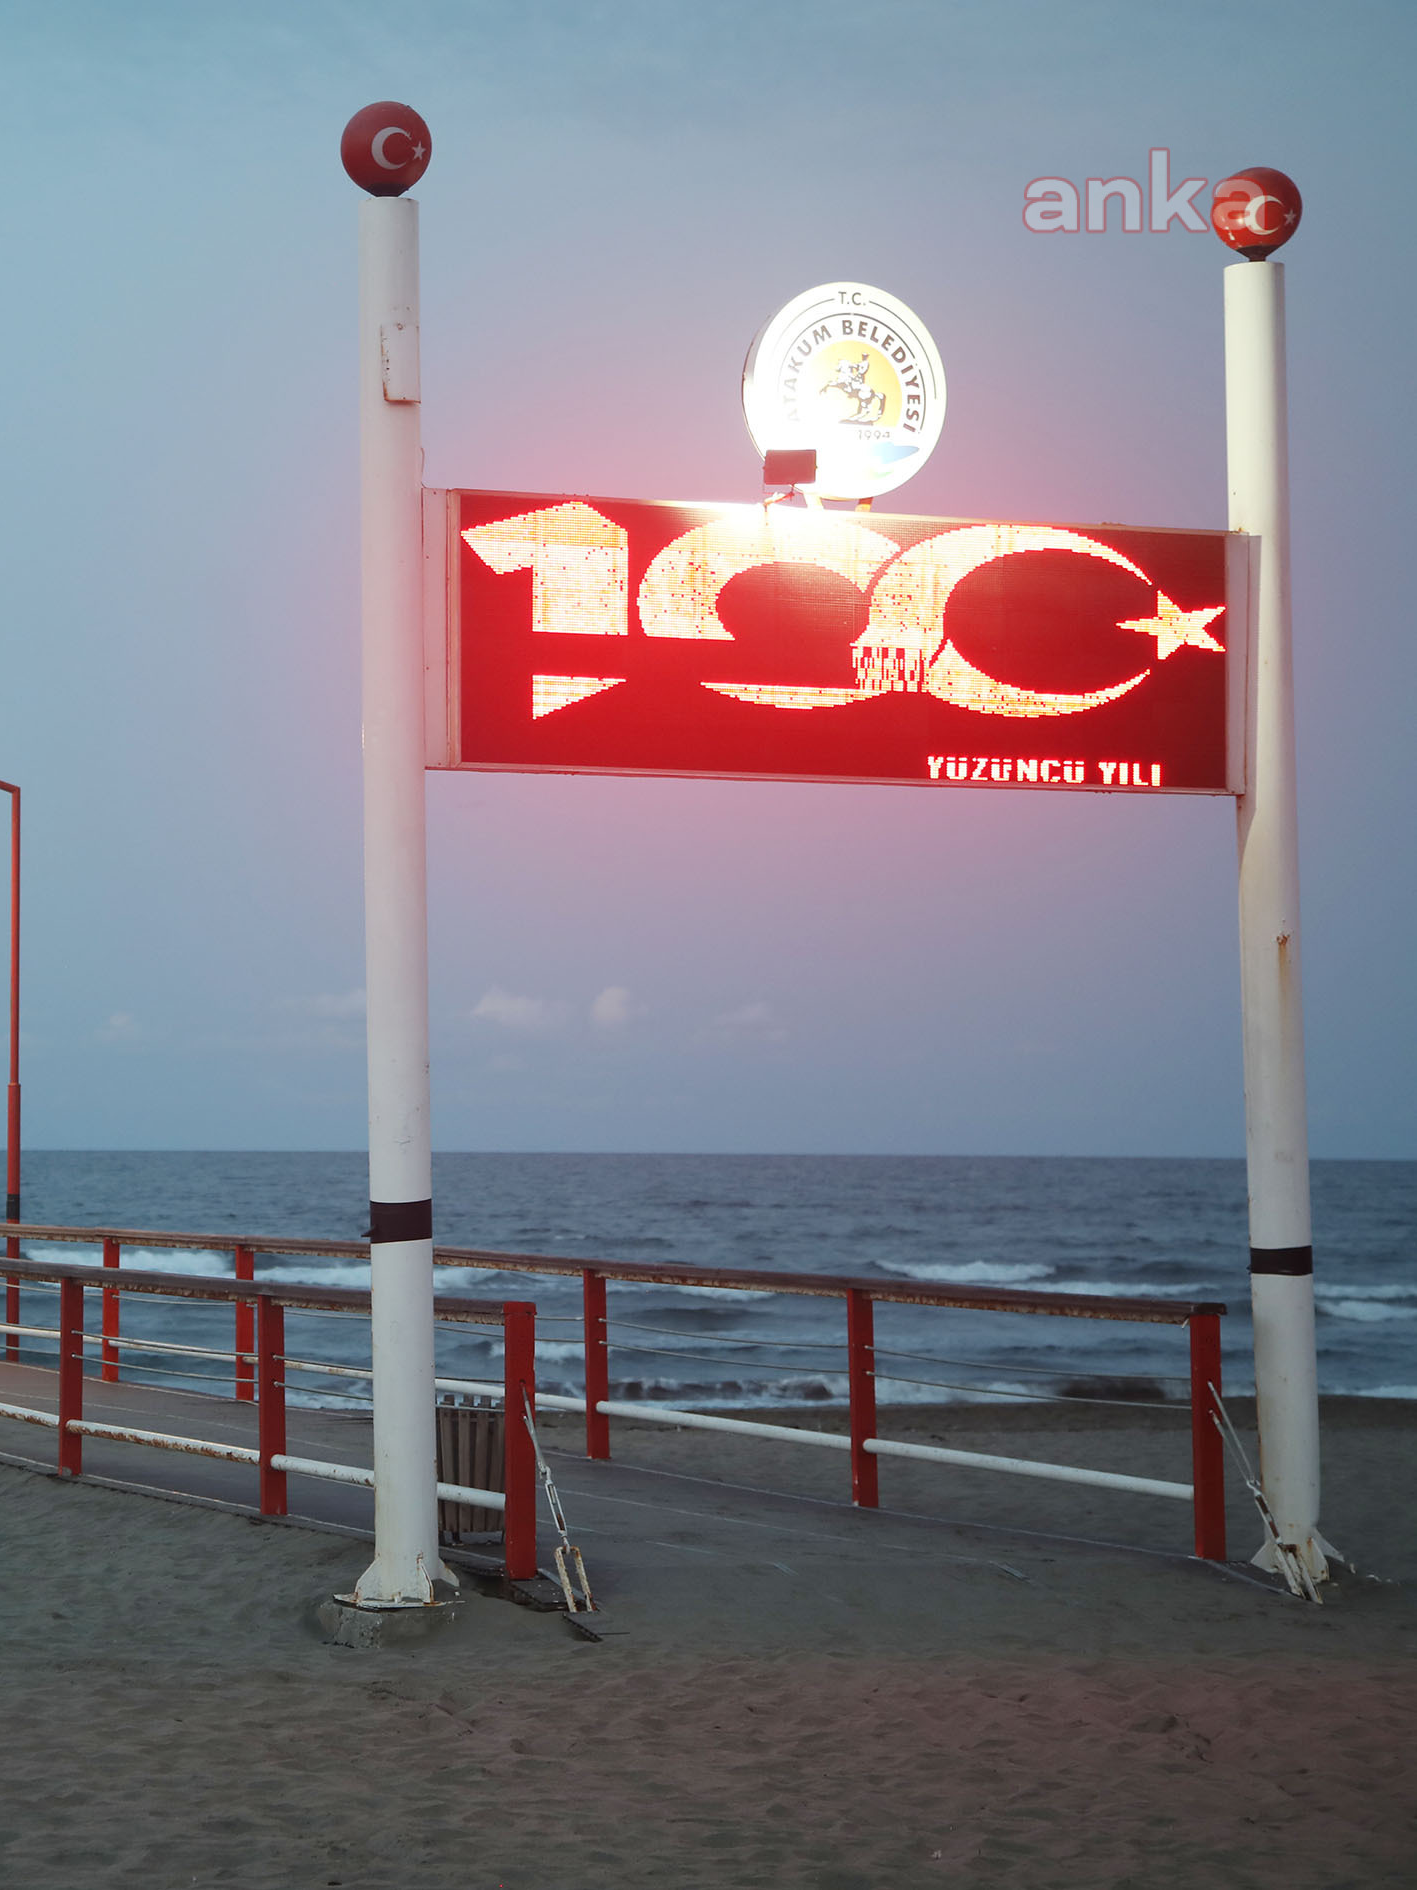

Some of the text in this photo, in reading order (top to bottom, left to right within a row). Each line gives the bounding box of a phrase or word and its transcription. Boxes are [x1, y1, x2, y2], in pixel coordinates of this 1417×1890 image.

[838, 291, 867, 306] T.C.
[927, 755, 1161, 787] YÜZÜNCÜ YILI
